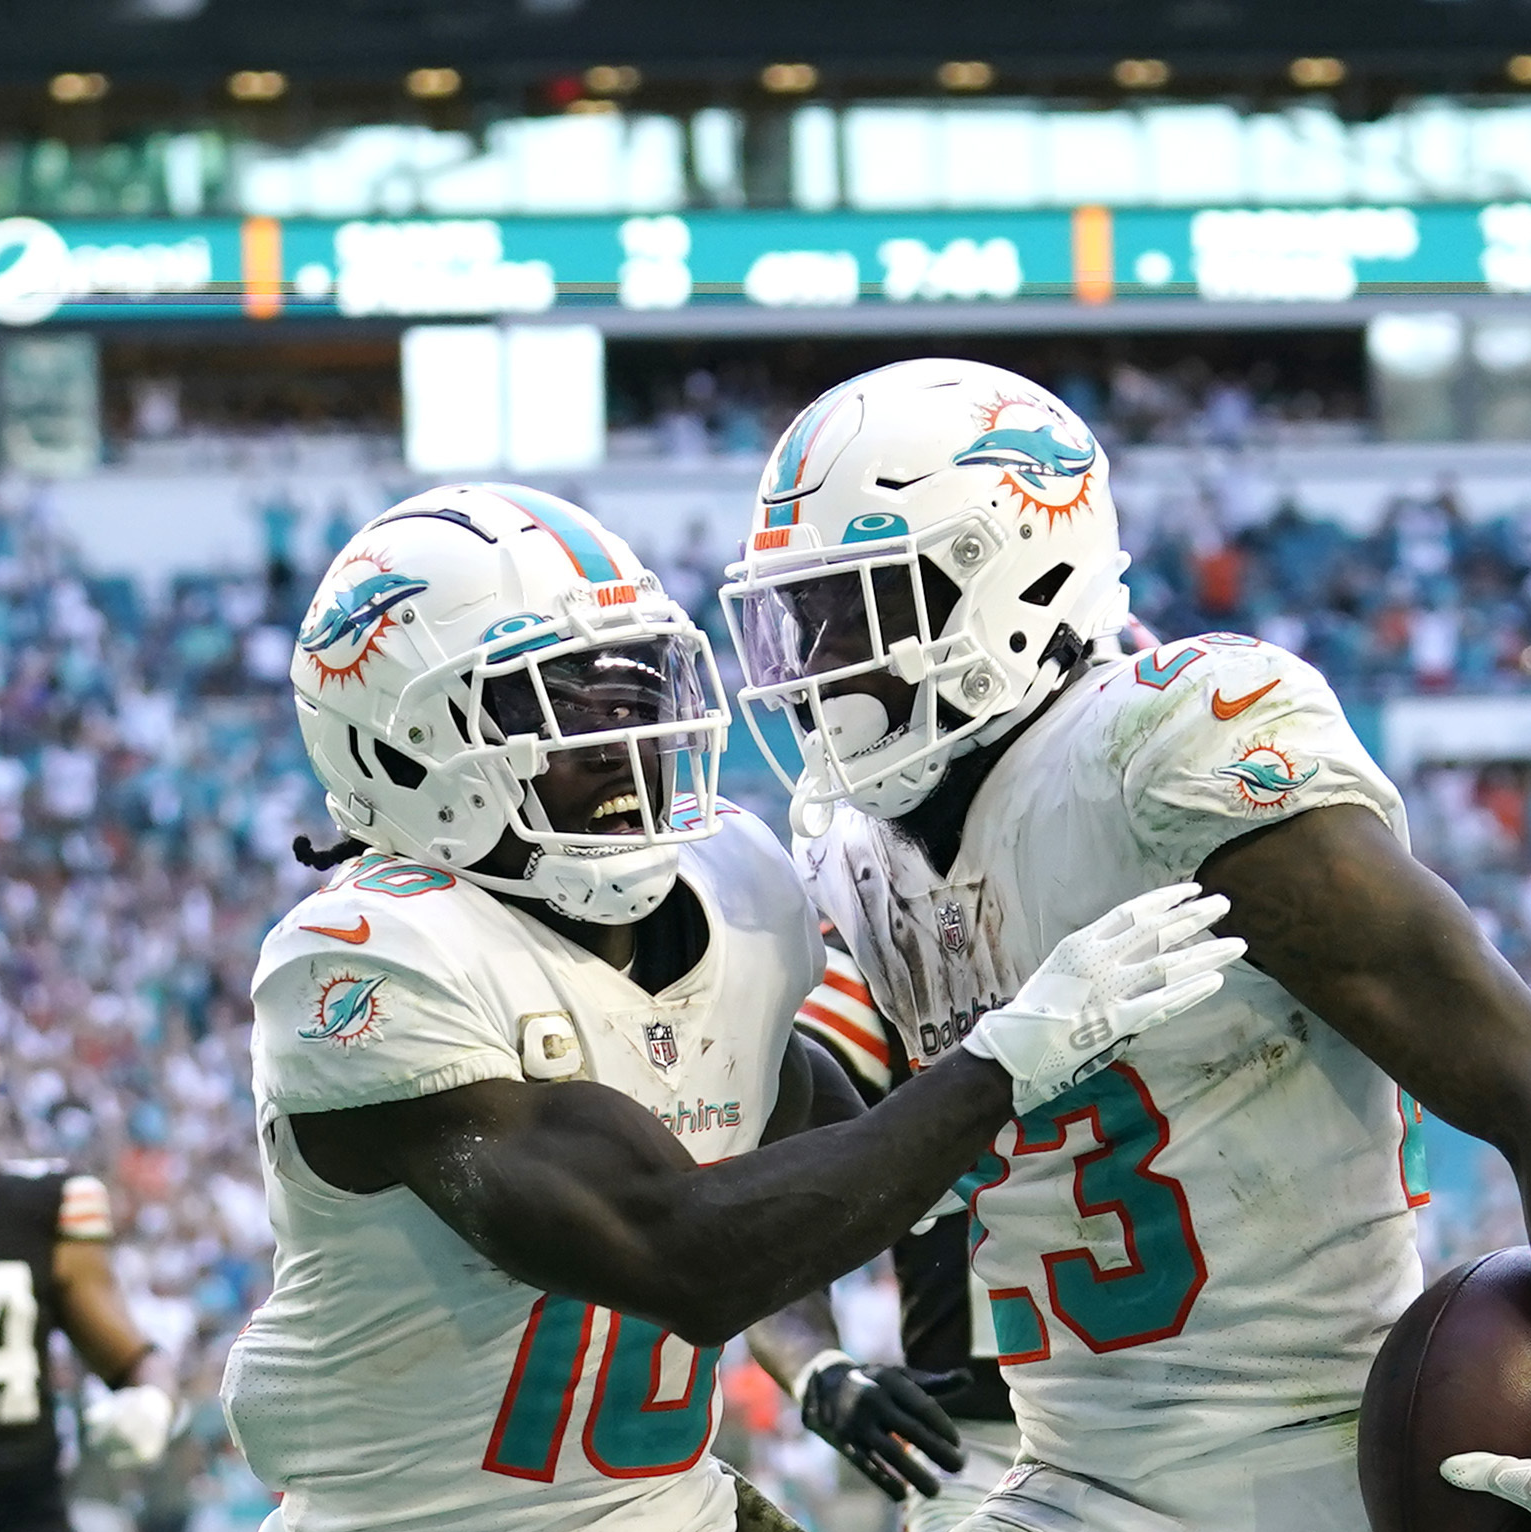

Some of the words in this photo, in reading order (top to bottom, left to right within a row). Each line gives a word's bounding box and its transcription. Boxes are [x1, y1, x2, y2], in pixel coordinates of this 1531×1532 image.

[317, 853, 456, 898] 10
[521, 1016, 582, 1081] C
[651, 1042, 675, 1062] NFL
